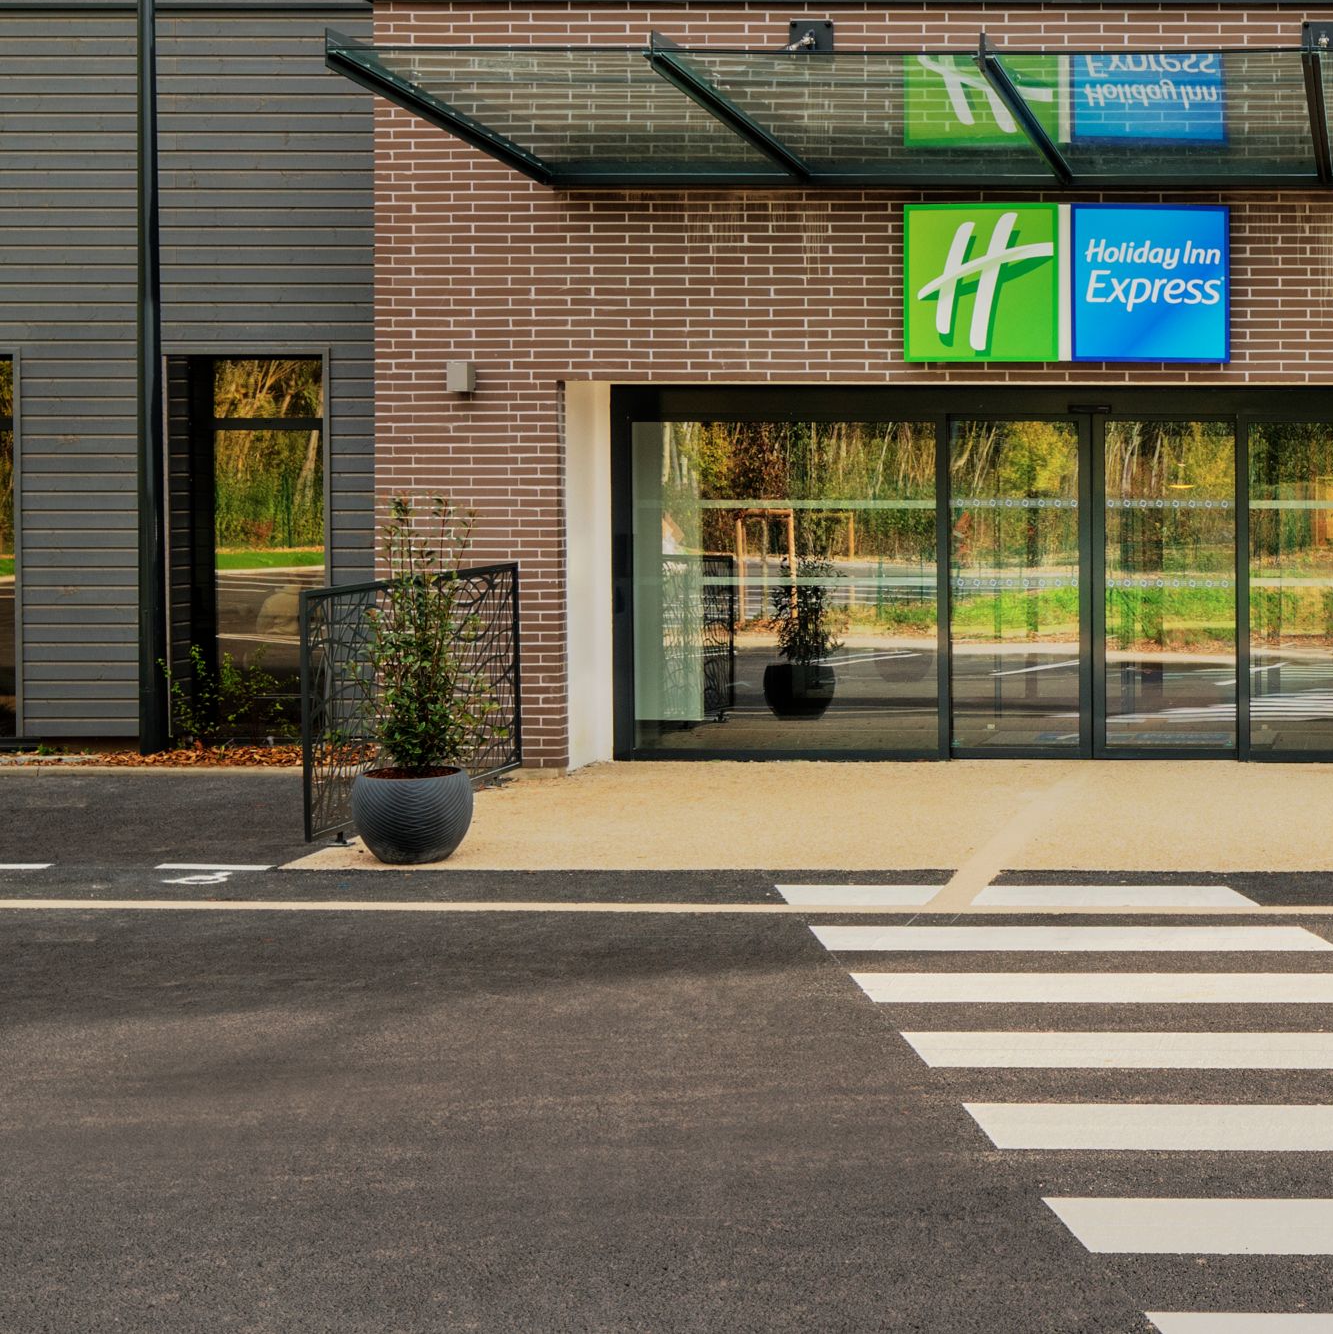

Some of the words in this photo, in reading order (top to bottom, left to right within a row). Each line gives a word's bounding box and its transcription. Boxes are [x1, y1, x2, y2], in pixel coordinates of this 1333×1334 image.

[1084, 238, 1181, 270] Holiday
[1183, 240, 1221, 265] Inn
[1085, 269, 1222, 312] Express
